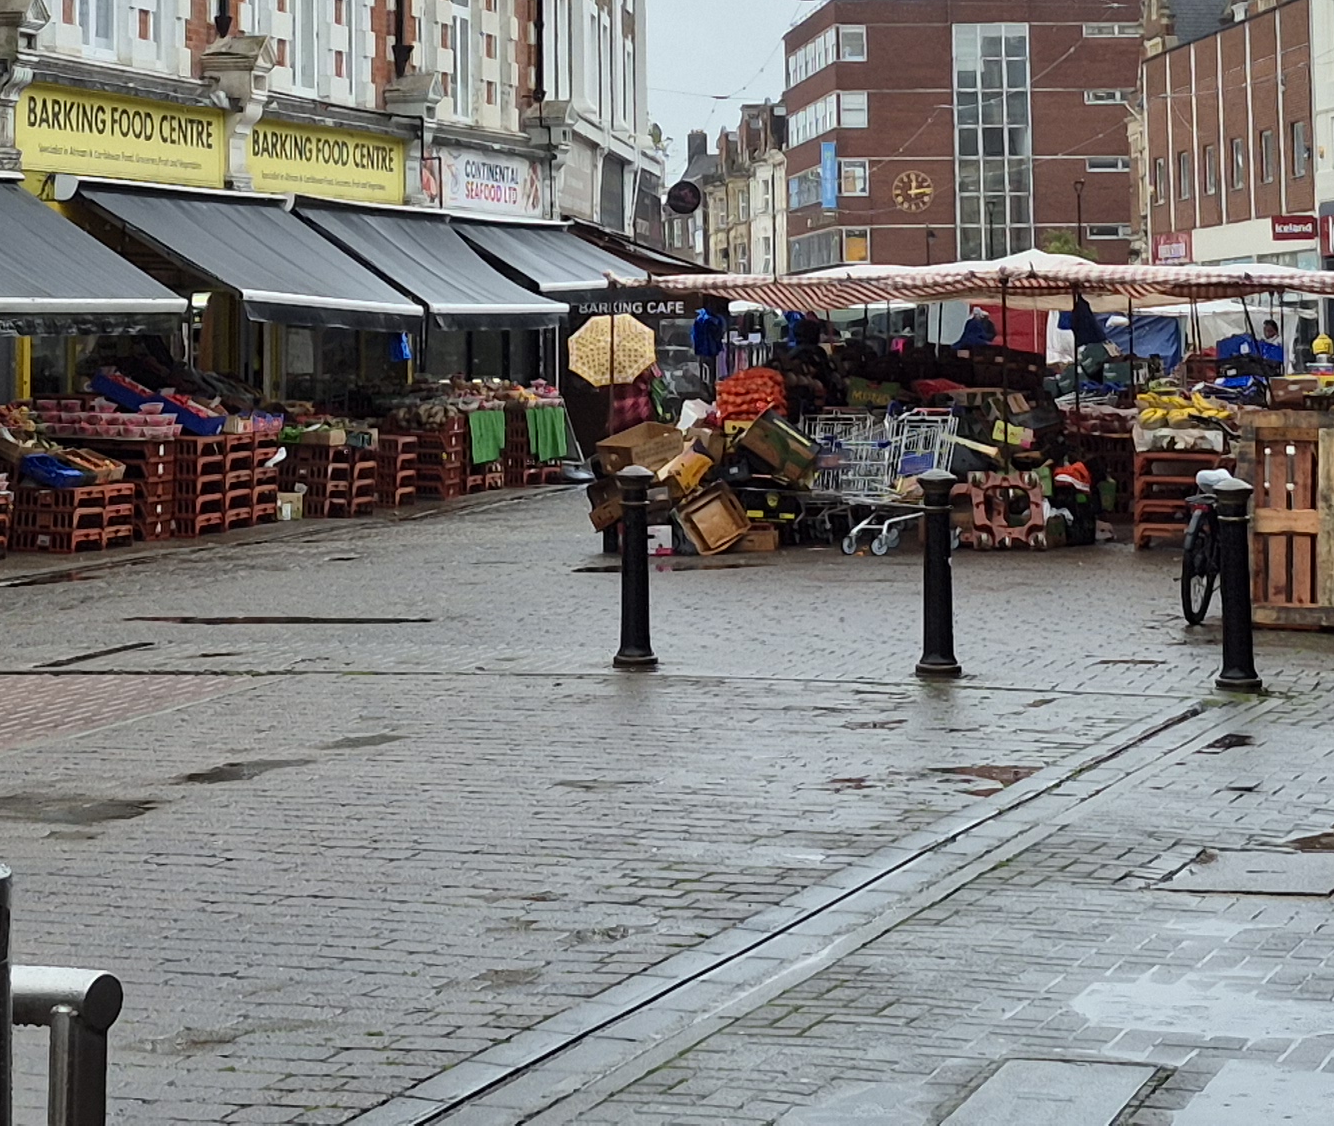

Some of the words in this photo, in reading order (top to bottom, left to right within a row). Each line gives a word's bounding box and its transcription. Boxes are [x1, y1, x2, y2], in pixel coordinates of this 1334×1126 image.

[26, 95, 107, 136] BARKING
[110, 105, 154, 142] FOOD
[159, 114, 214, 150] CENTRE
[252, 128, 313, 162] BARKING
[315, 136, 349, 166] FOOD
[352, 143, 395, 173] CENTRE
[464, 159, 519, 184] CONTINENTAL
[465, 181, 503, 202] SEAFOOD
[503, 186, 518, 205] LTD
[1275, 222, 1313, 234] Iceland
[578, 302, 644, 314] BARKING
[647, 301, 685, 314] CAFE
